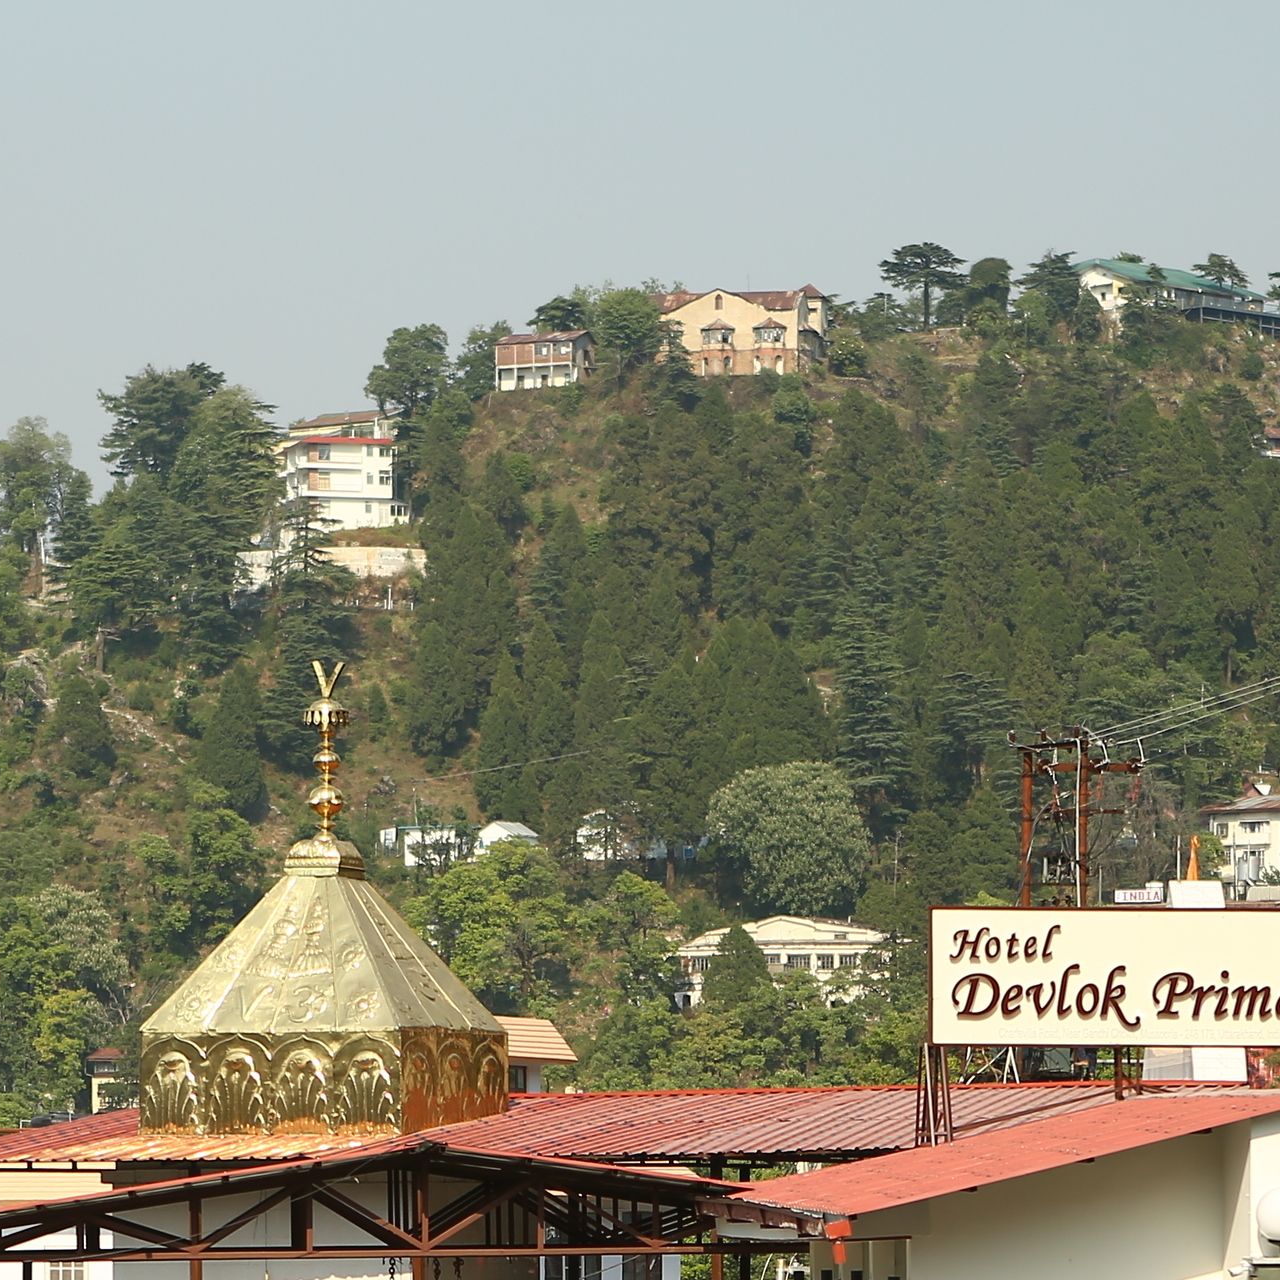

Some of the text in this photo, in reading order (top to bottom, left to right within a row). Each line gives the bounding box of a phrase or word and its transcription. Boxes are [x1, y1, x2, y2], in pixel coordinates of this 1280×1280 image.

[1123, 891, 1160, 901] INDIA
[949, 924, 1062, 963] Hotel
[951, 963, 1141, 1032] Devlok
